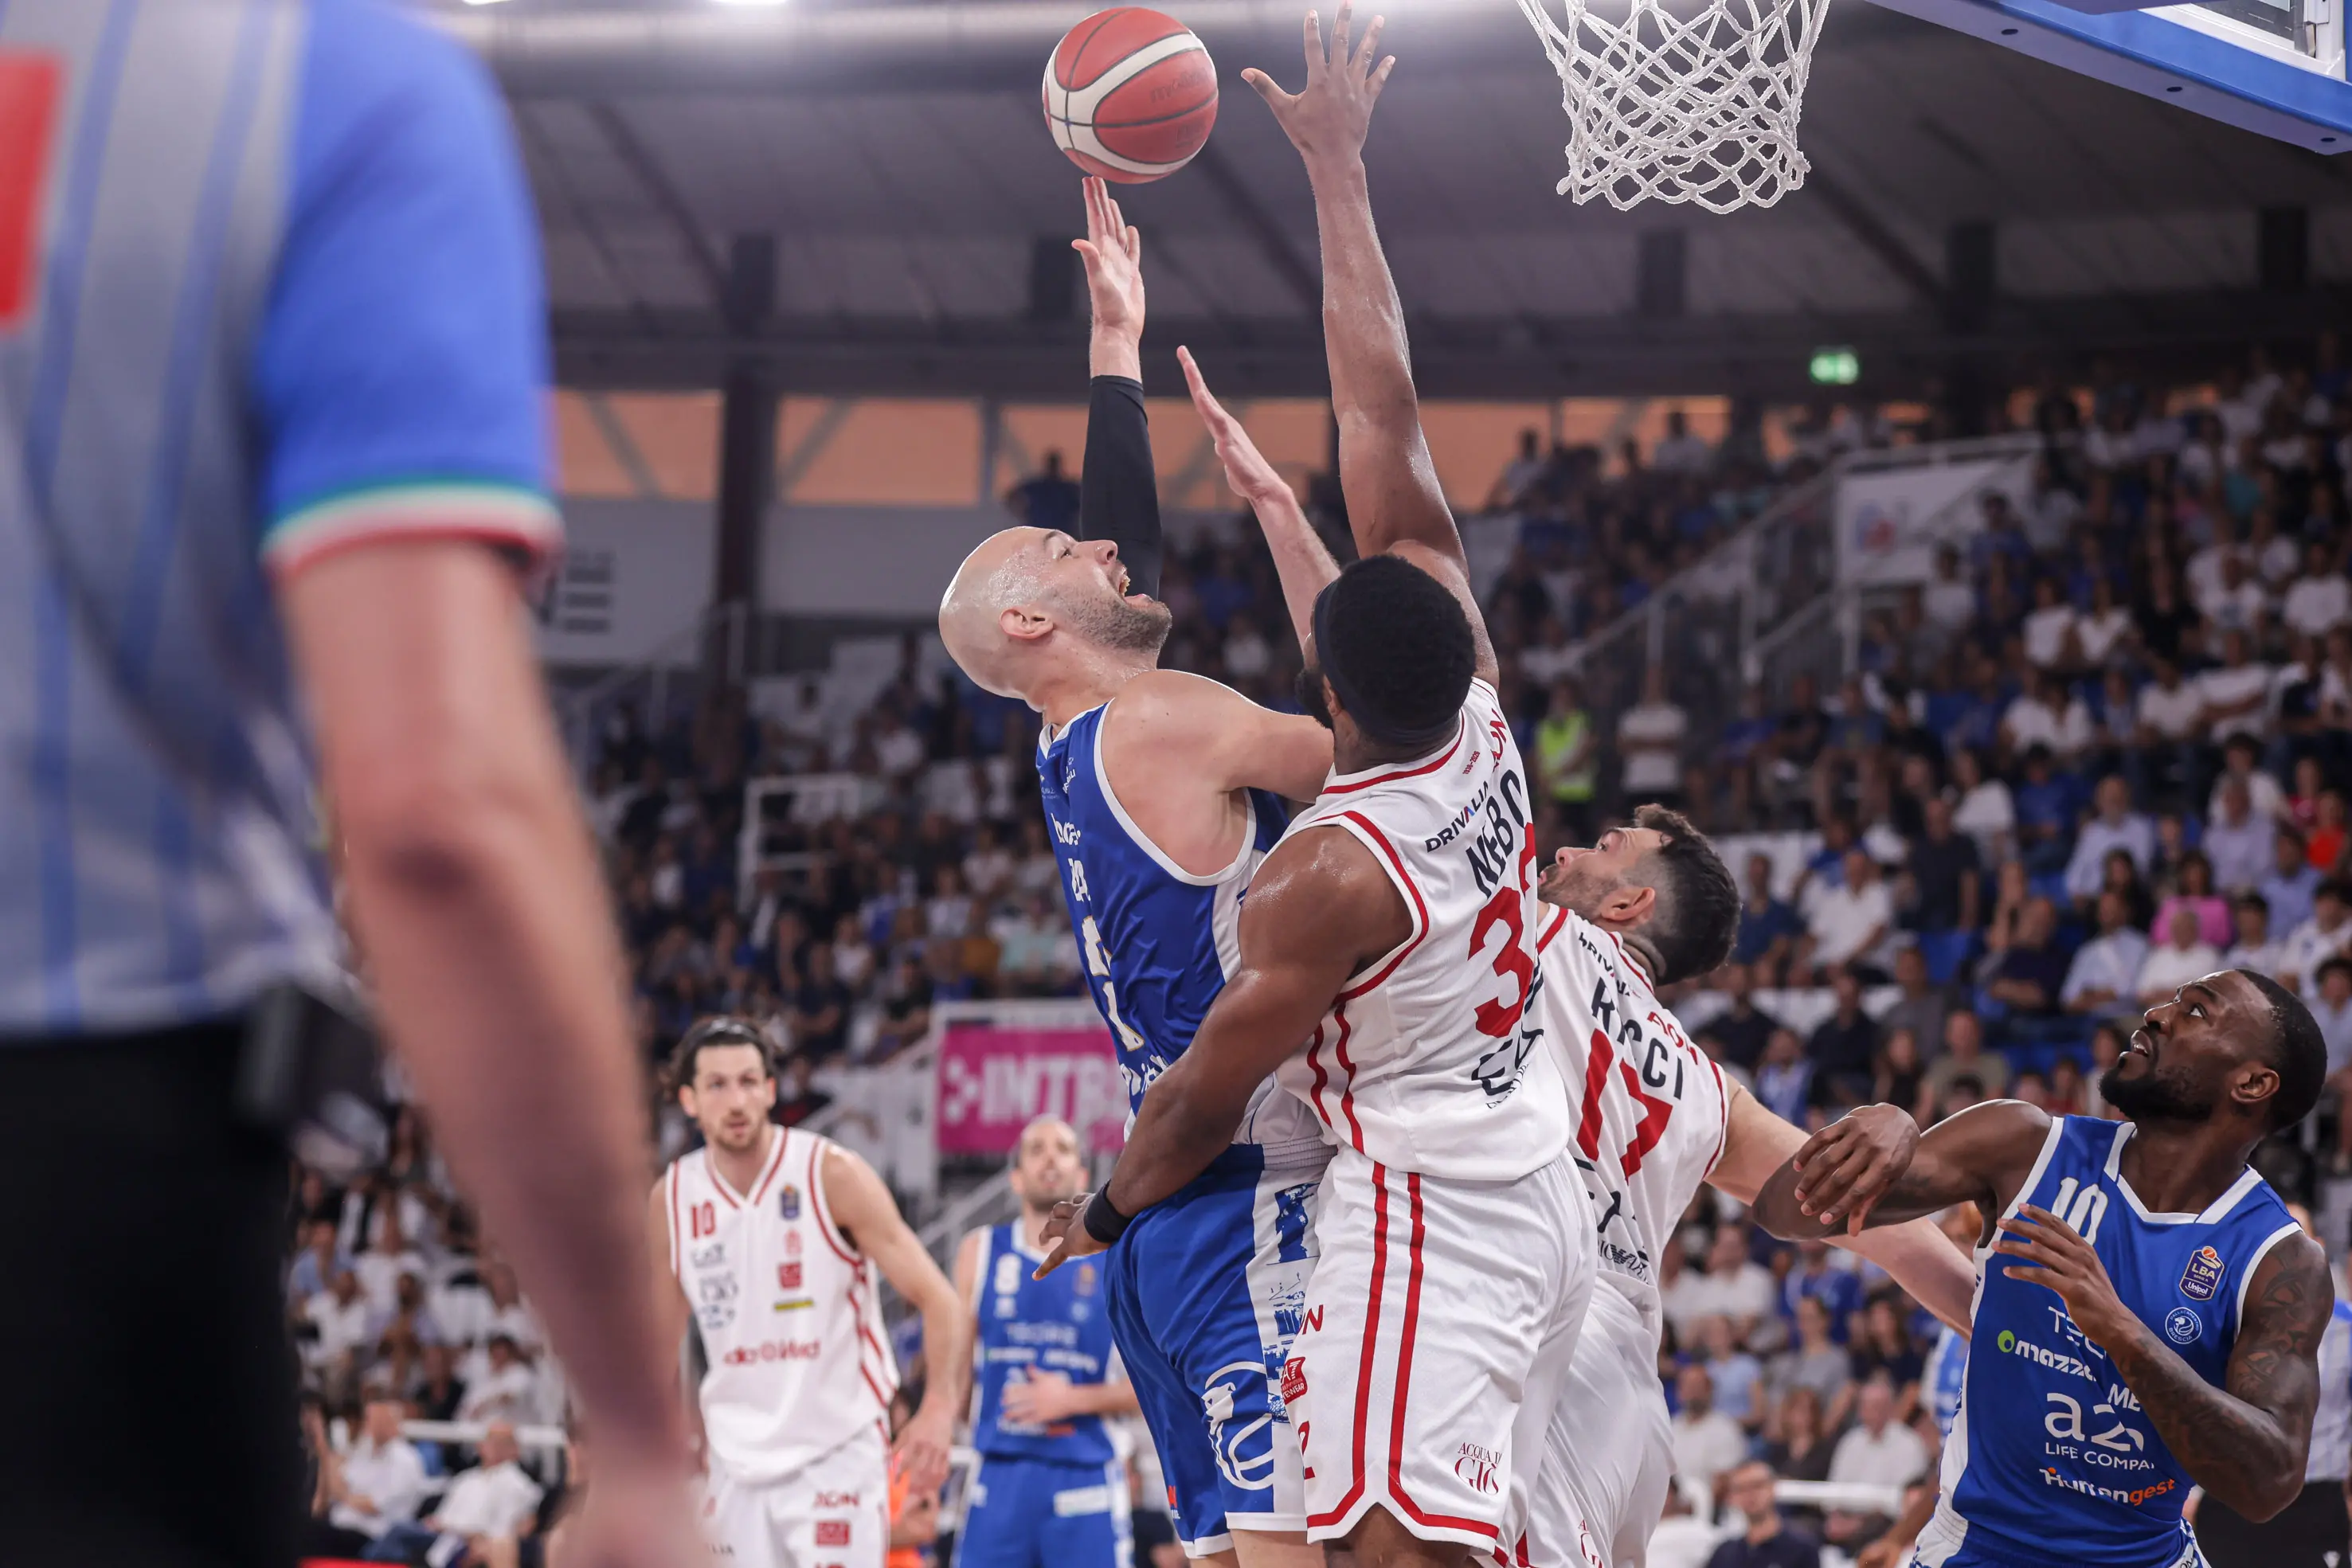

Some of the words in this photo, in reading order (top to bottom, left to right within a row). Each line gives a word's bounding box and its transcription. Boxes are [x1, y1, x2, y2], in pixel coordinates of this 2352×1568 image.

[1466, 769, 1525, 900] NEBO
[1467, 822, 1536, 1038] 3
[1592, 976, 1684, 1101] RCCI
[1577, 1028, 1673, 1186] 17
[691, 1201, 715, 1240] 10
[2051, 1177, 2108, 1247] 10
[2187, 1281, 2208, 1296] Unipol
[2191, 1262, 2215, 1280] LBA
[2048, 1306, 2107, 1360] TEC
[2169, 1328, 2193, 1342] BRESCIA
[2107, 1383, 2141, 1412] ME
[1458, 1442, 1491, 1462] ACQUA
[2045, 1442, 2079, 1460] LIFE
[2084, 1451, 2155, 1471] COMPA
[1454, 1456, 1499, 1496] GIÒ
